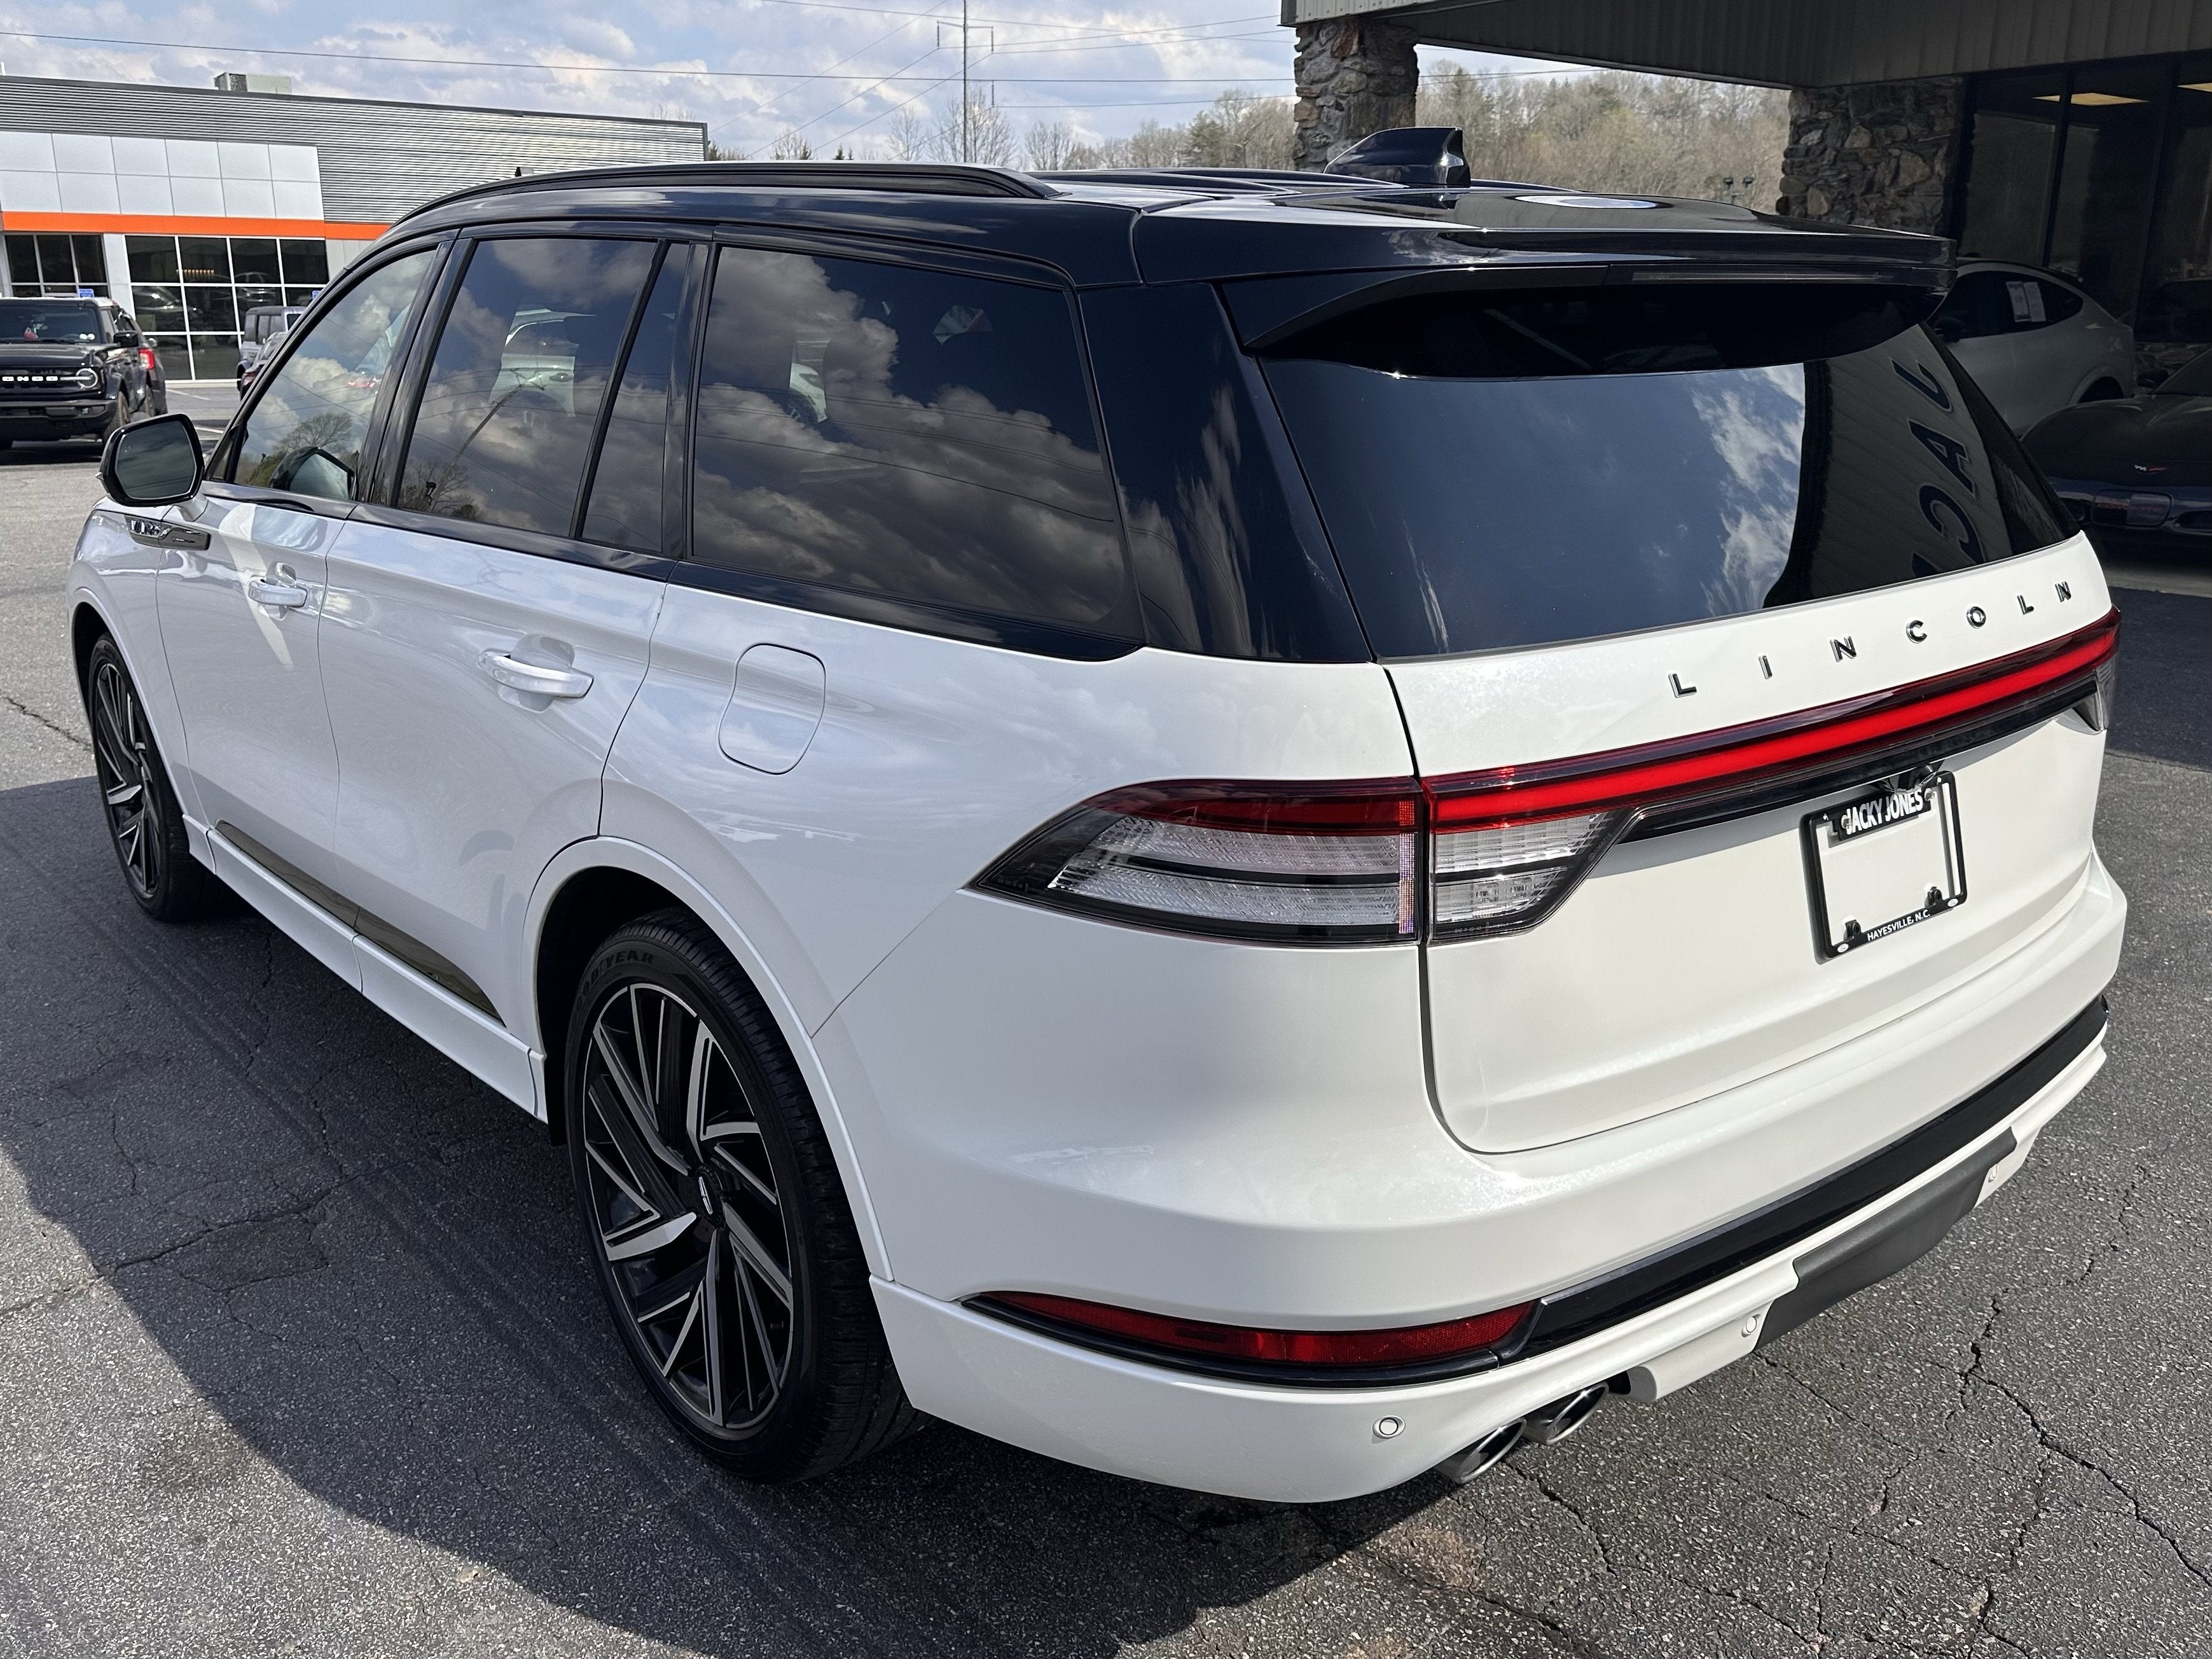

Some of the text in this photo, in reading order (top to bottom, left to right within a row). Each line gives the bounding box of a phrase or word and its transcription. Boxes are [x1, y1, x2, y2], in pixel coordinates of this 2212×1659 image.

[1668, 580, 2072, 698] LINCOLN
[1844, 788, 1923, 835] JACKY JONES
[1867, 909, 1931, 941] HAYESVILLE, N.C.
